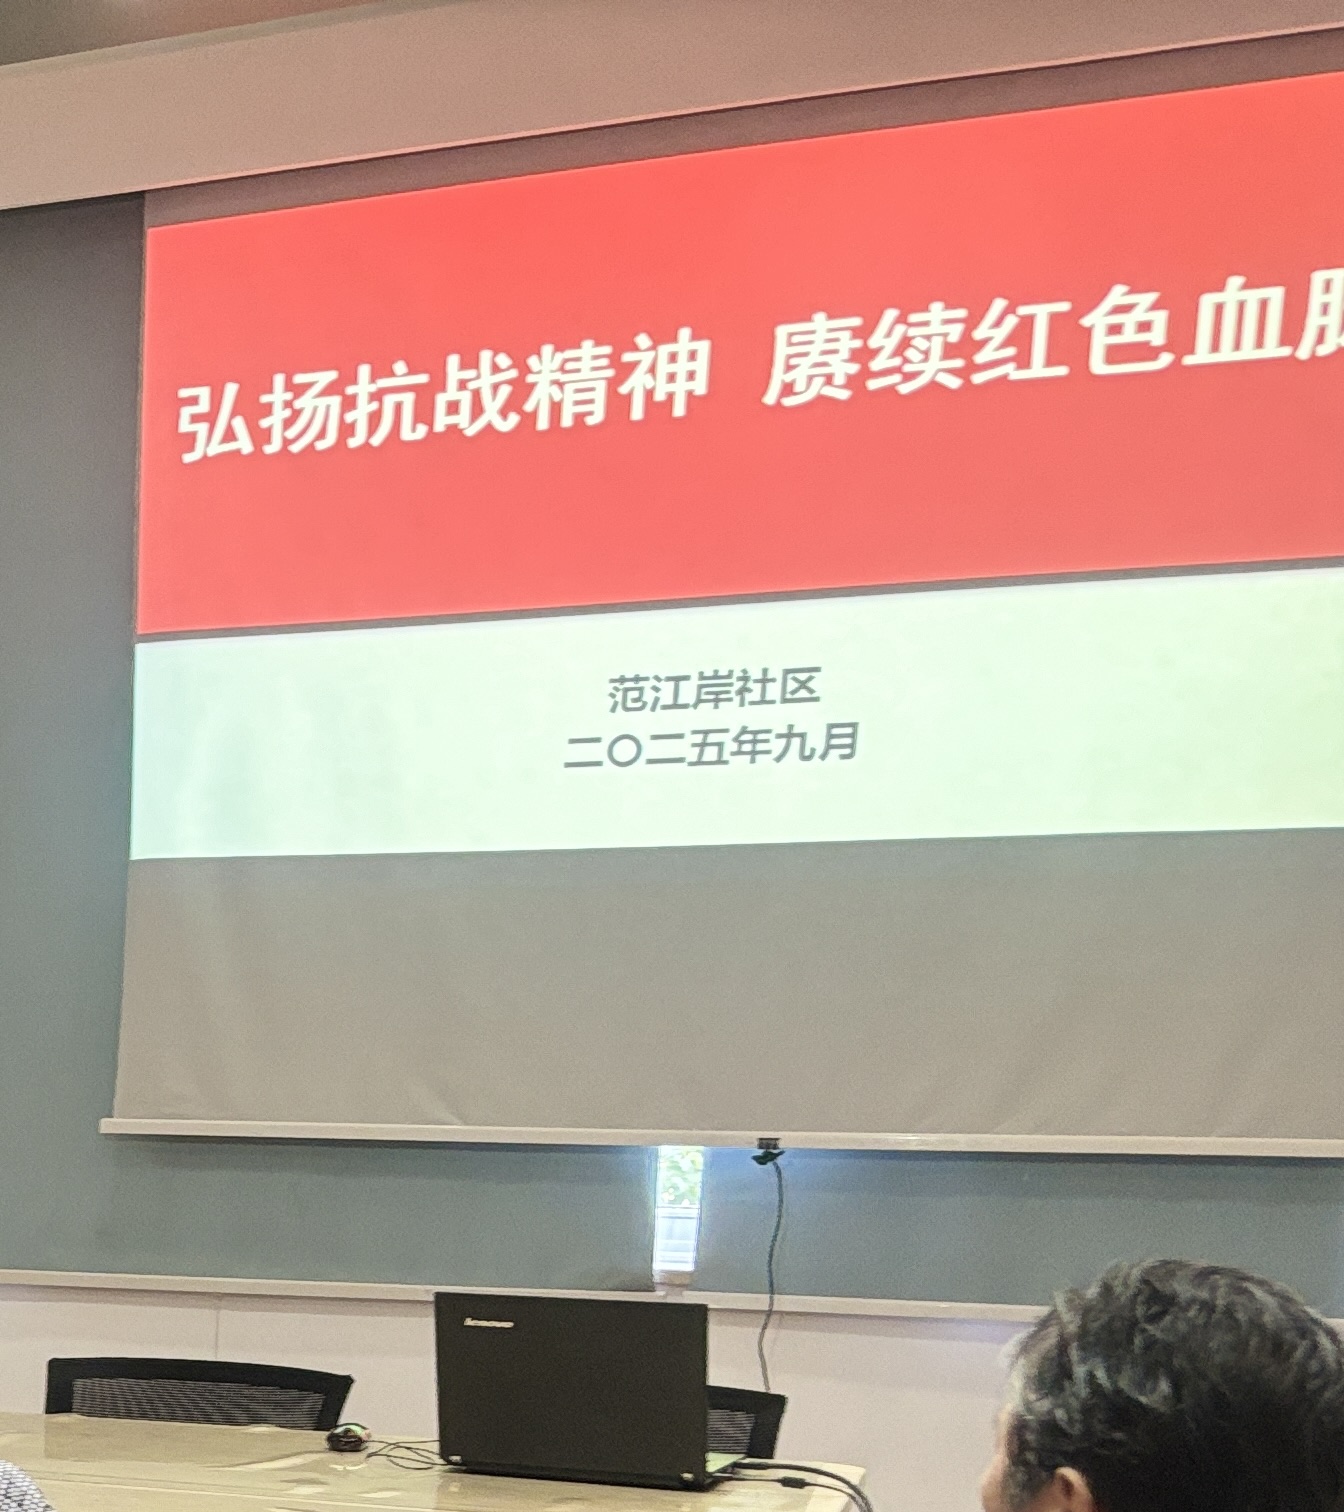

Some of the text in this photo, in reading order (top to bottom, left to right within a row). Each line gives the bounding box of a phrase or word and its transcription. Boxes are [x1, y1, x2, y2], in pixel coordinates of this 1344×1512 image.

[176, 326, 712, 464] 弘扬抗战精神
[608, 666, 822, 713] 范江岸社区
